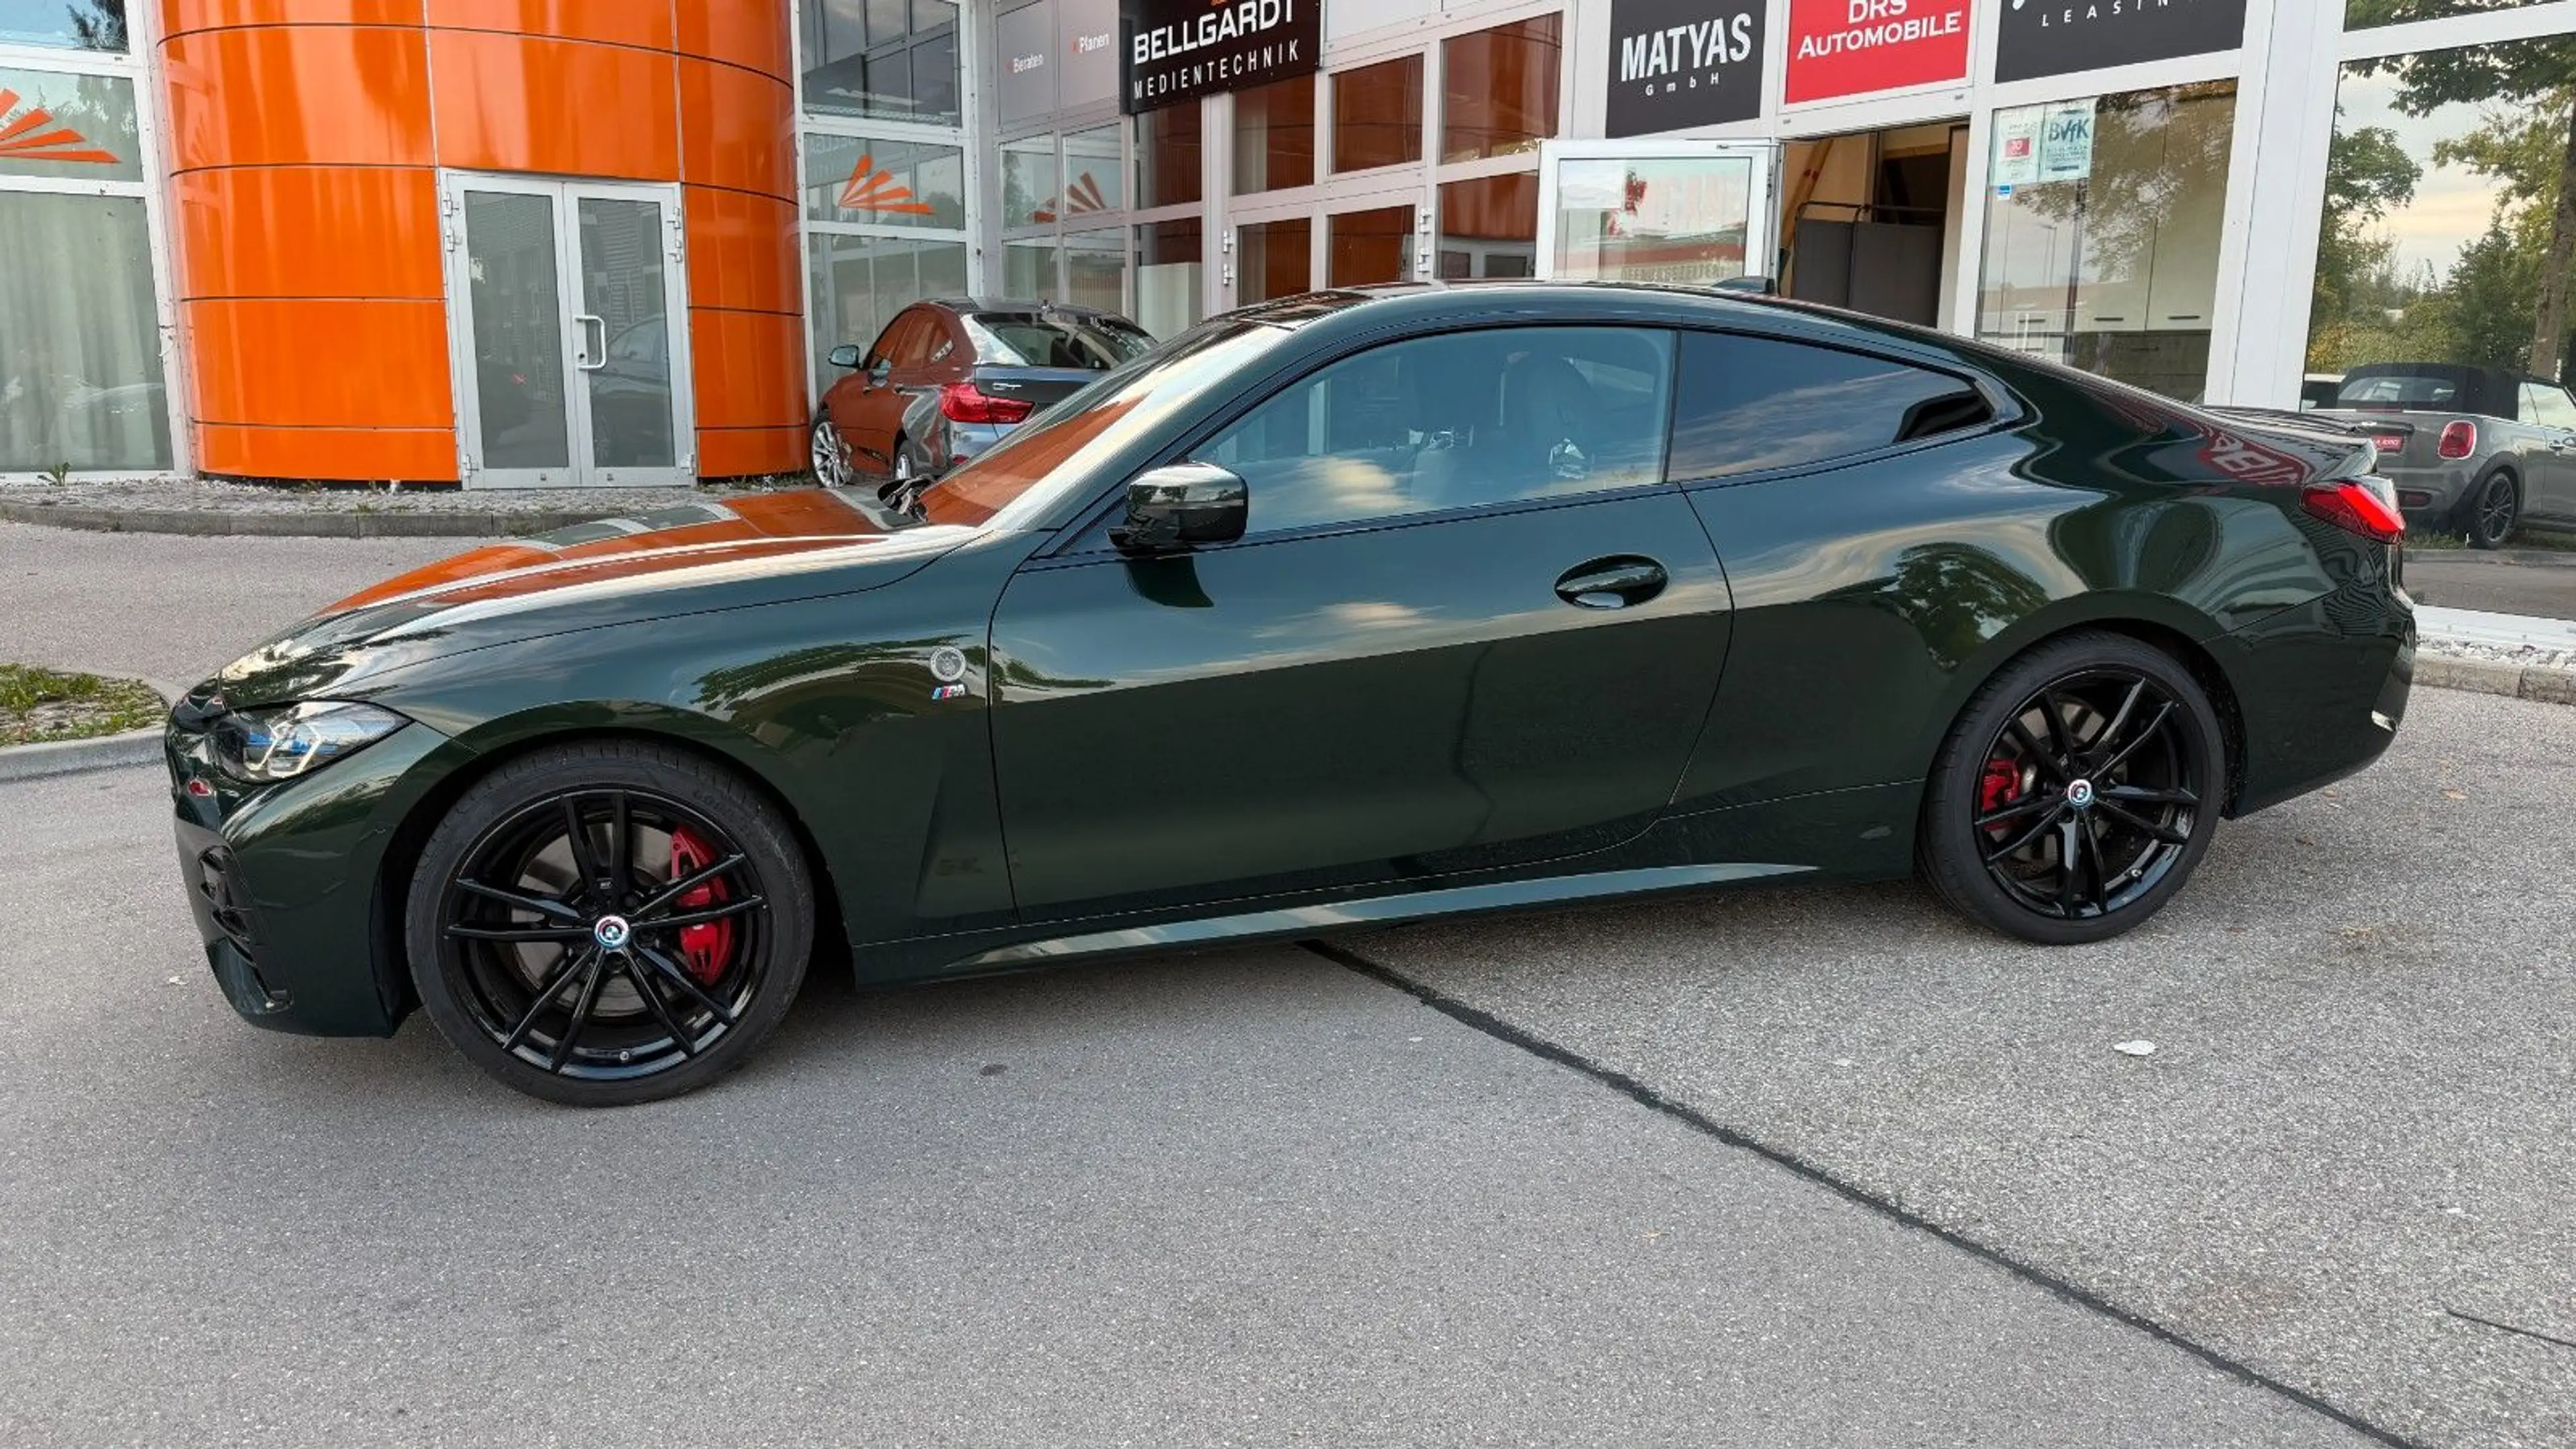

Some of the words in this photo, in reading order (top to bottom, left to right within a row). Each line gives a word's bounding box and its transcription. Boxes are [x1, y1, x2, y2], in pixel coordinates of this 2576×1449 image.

[1134, 0, 1293, 65] BELLGARDT
[1797, 11, 1962, 60] AUTOMOBILE
[1848, 0, 1907, 23] DRS
[1012, 53, 1044, 74] Beraten
[1078, 33, 1110, 54] Planen
[1621, 12, 1752, 82] MATYAS
[1134, 39, 1299, 99] MEDIENTECHNIK
